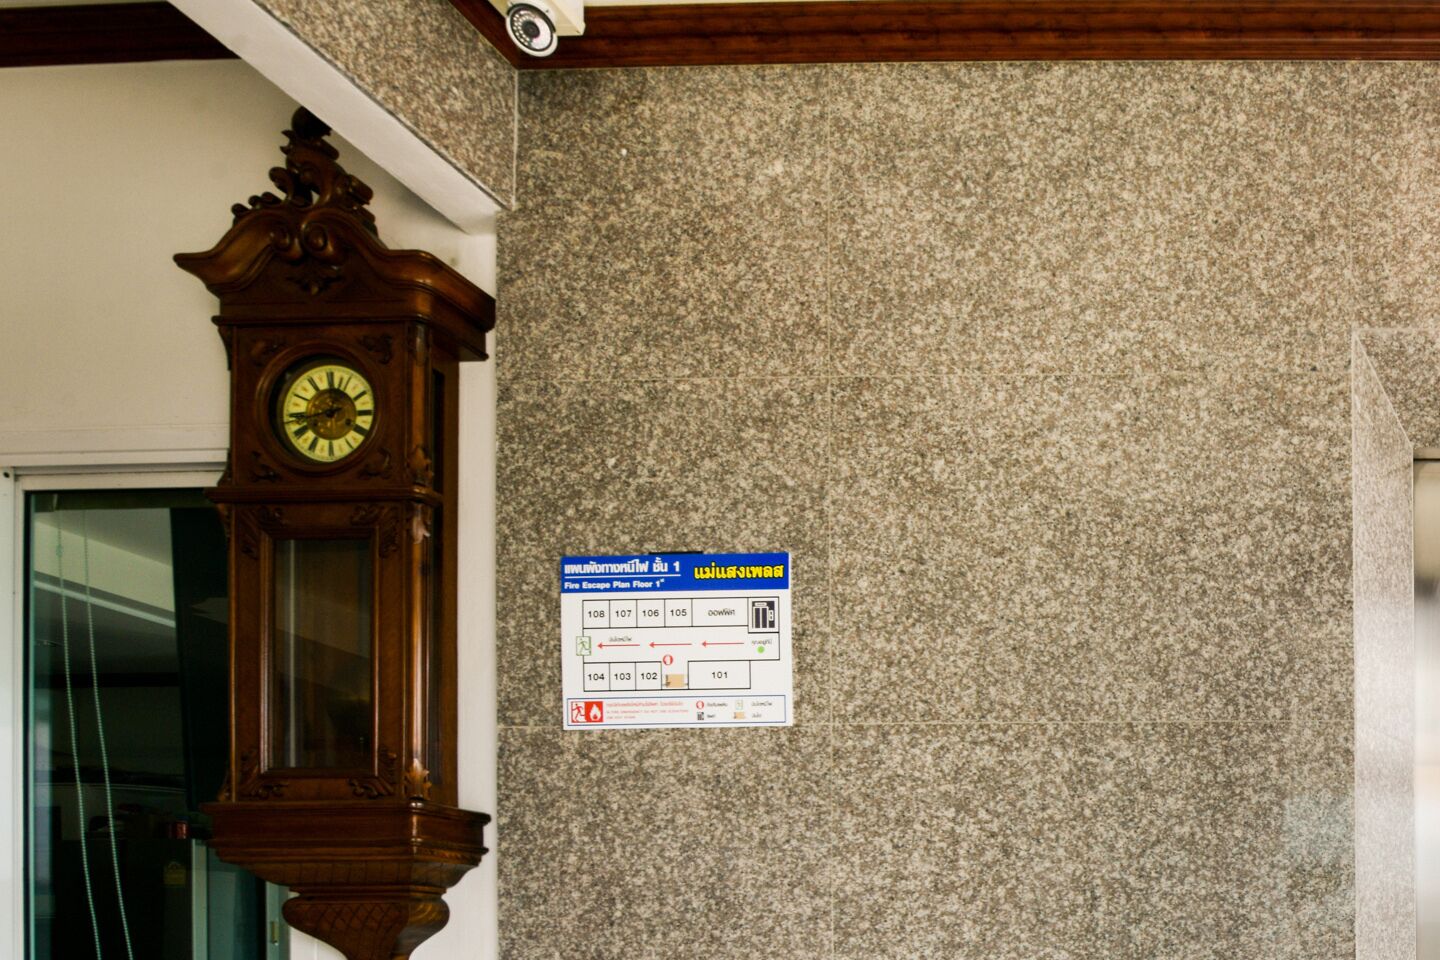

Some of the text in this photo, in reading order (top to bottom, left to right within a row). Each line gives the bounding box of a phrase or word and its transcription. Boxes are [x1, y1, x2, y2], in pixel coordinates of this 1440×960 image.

[673, 560, 680, 572] 1
[693, 561, 784, 579] แม่แสงเพลส
[564, 581, 580, 590] Fire
[582, 580, 611, 590] Escape
[612, 580, 631, 589] Plan
[632, 579, 653, 588] Floor
[588, 610, 605, 618] 108
[615, 609, 632, 618] 107
[642, 609, 660, 617] 106
[670, 608, 687, 617] 105
[588, 673, 605, 681] 104
[614, 672, 631, 680] 103
[640, 672, 658, 680] 102
[711, 671, 728, 679] 101
